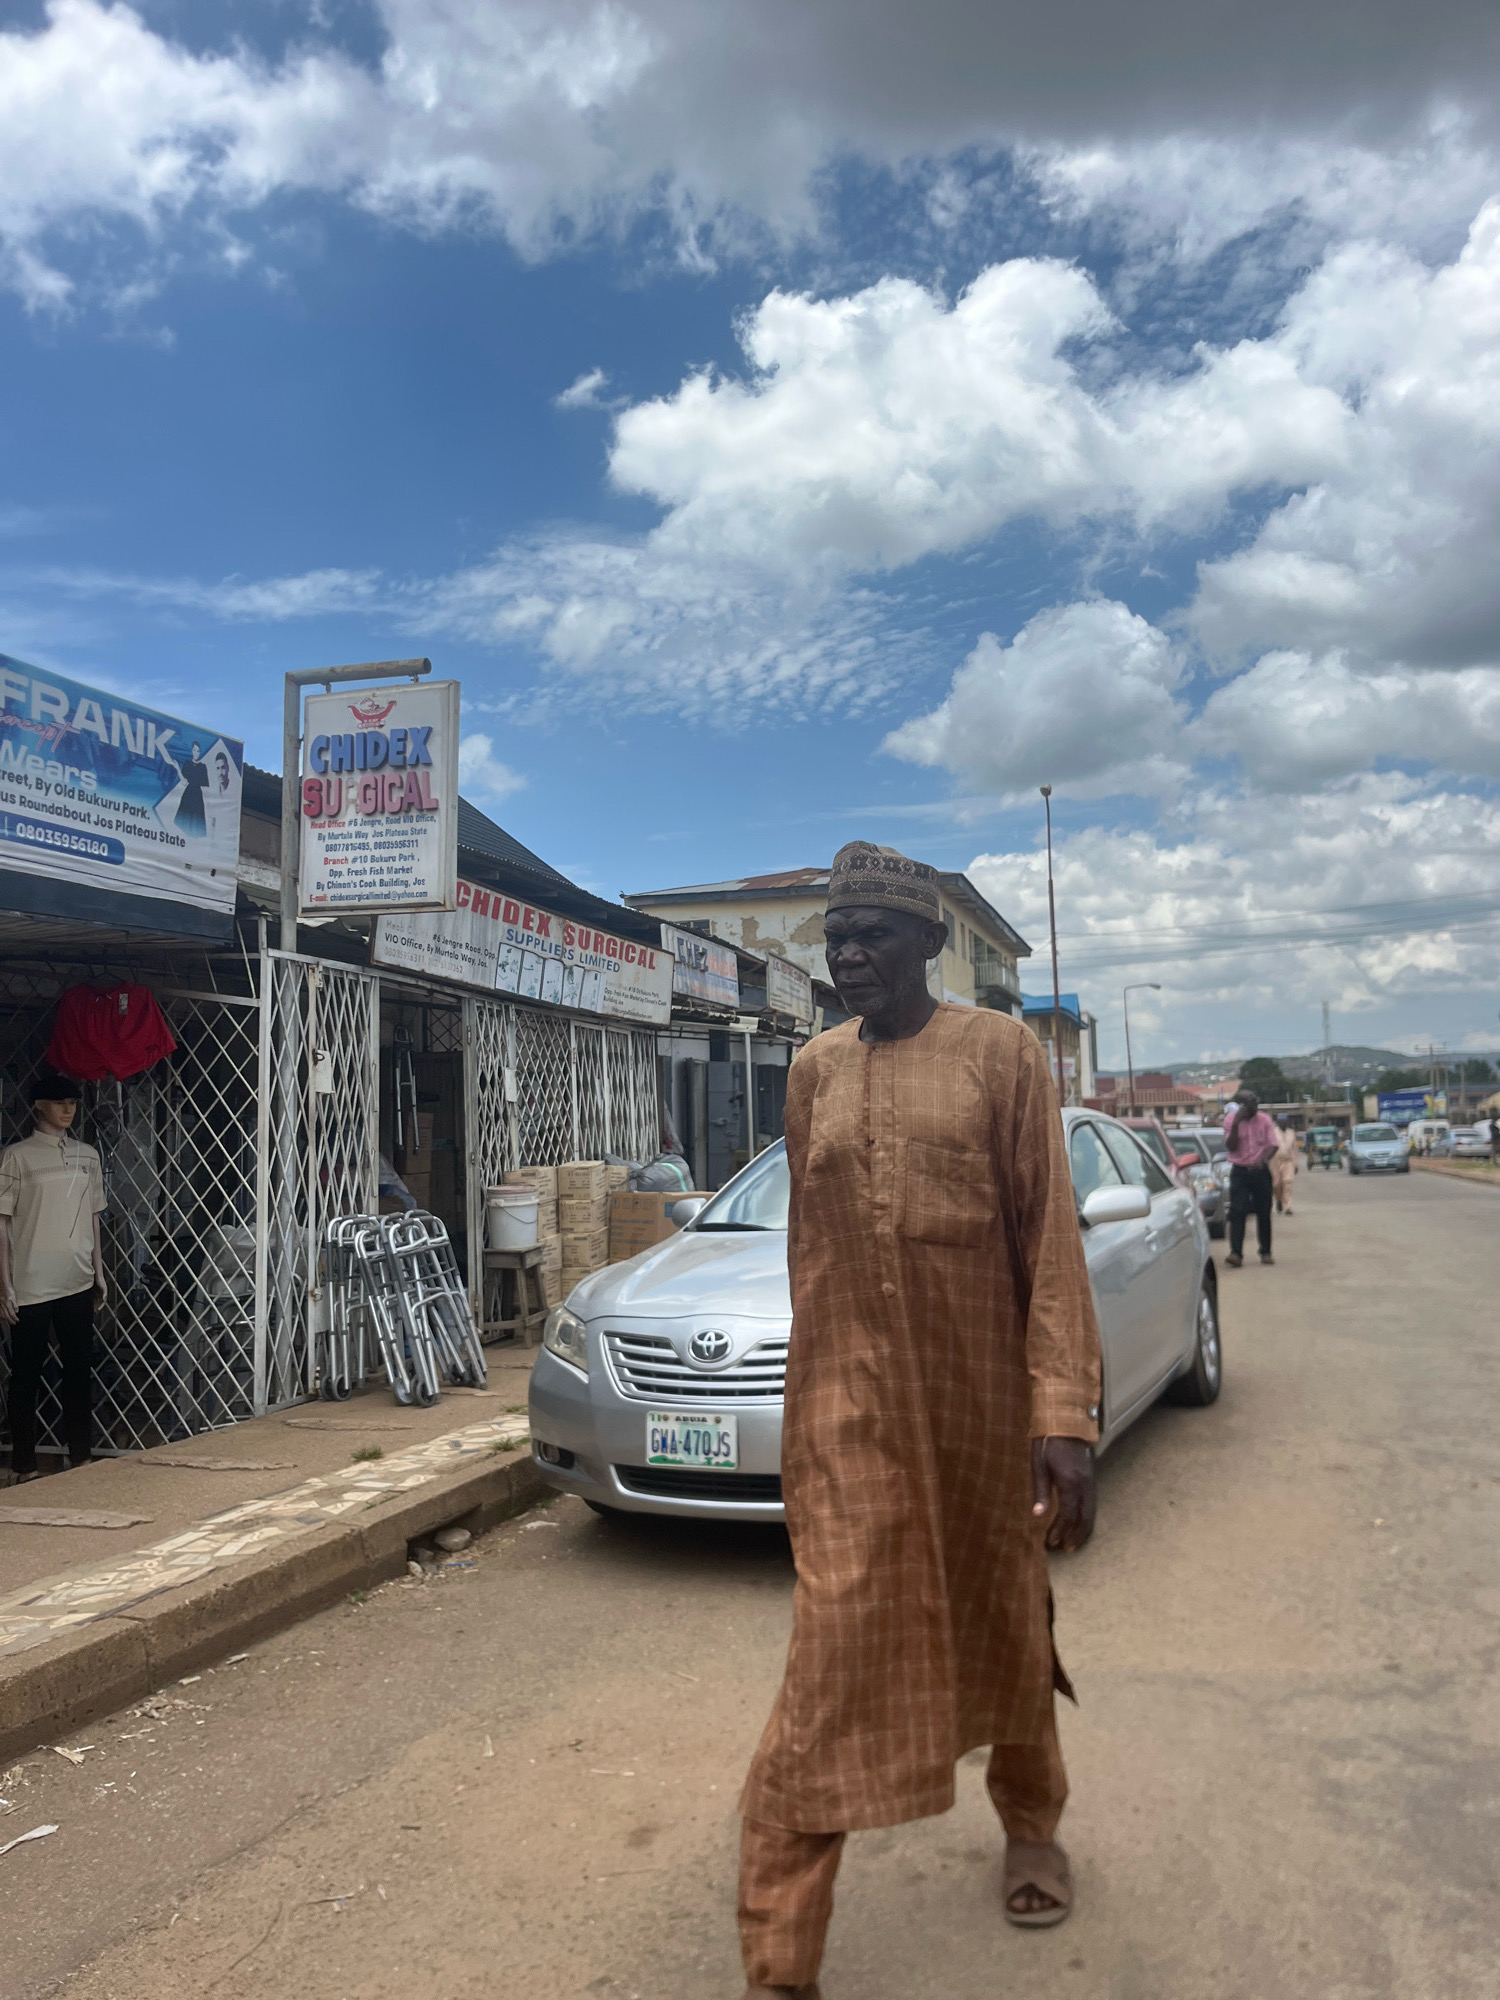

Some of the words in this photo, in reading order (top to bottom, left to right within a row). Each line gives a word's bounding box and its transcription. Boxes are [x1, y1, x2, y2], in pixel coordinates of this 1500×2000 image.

[0, 668, 176, 765] FRANK
[310, 726, 433, 773] CHIDEX
[0, 769, 32, 790] reet,
[36, 777, 51, 796] By
[54, 783, 75, 799] Old
[78, 789, 120, 812] Bukuru
[123, 802, 150, 820] Park.
[19, 795, 91, 824] Roundabout
[94, 814, 113, 829] Jos
[115, 820, 157, 840] Plateau
[159, 831, 186, 847] State
[311, 821, 326, 829] Head
[327, 820, 346, 828] Office
[385, 816, 401, 825] Road
[415, 814, 436, 823] Office,
[317, 832, 326, 842] By
[355, 830, 369, 840] Way
[372, 830, 384, 838] Jos
[385, 829, 409, 837] Plateau
[410, 827, 427, 836] State
[16, 823, 108, 856] 08035956180
[323, 856, 349, 865] Branch
[351, 854, 368, 864] #10
[370, 854, 397, 863] Bukuru
[329, 868, 345, 878] Opp.
[347, 867, 367, 876] Fresh
[370, 866, 384, 876] Fish
[386, 865, 413, 874] Market
[316, 881, 325, 891] By
[359, 879, 377, 888] Cook
[379, 878, 411, 888] Building,
[413, 877, 426, 886] Jos
[457, 881, 552, 937] CHIDEX
[563, 922, 656, 970] SURGICAL
[385, 932, 399, 944] VIO
[401, 936, 425, 951] Office,
[426, 943, 434, 954] By
[506, 929, 574, 961] SUPPLIERS
[579, 953, 621, 973] LIMITED
